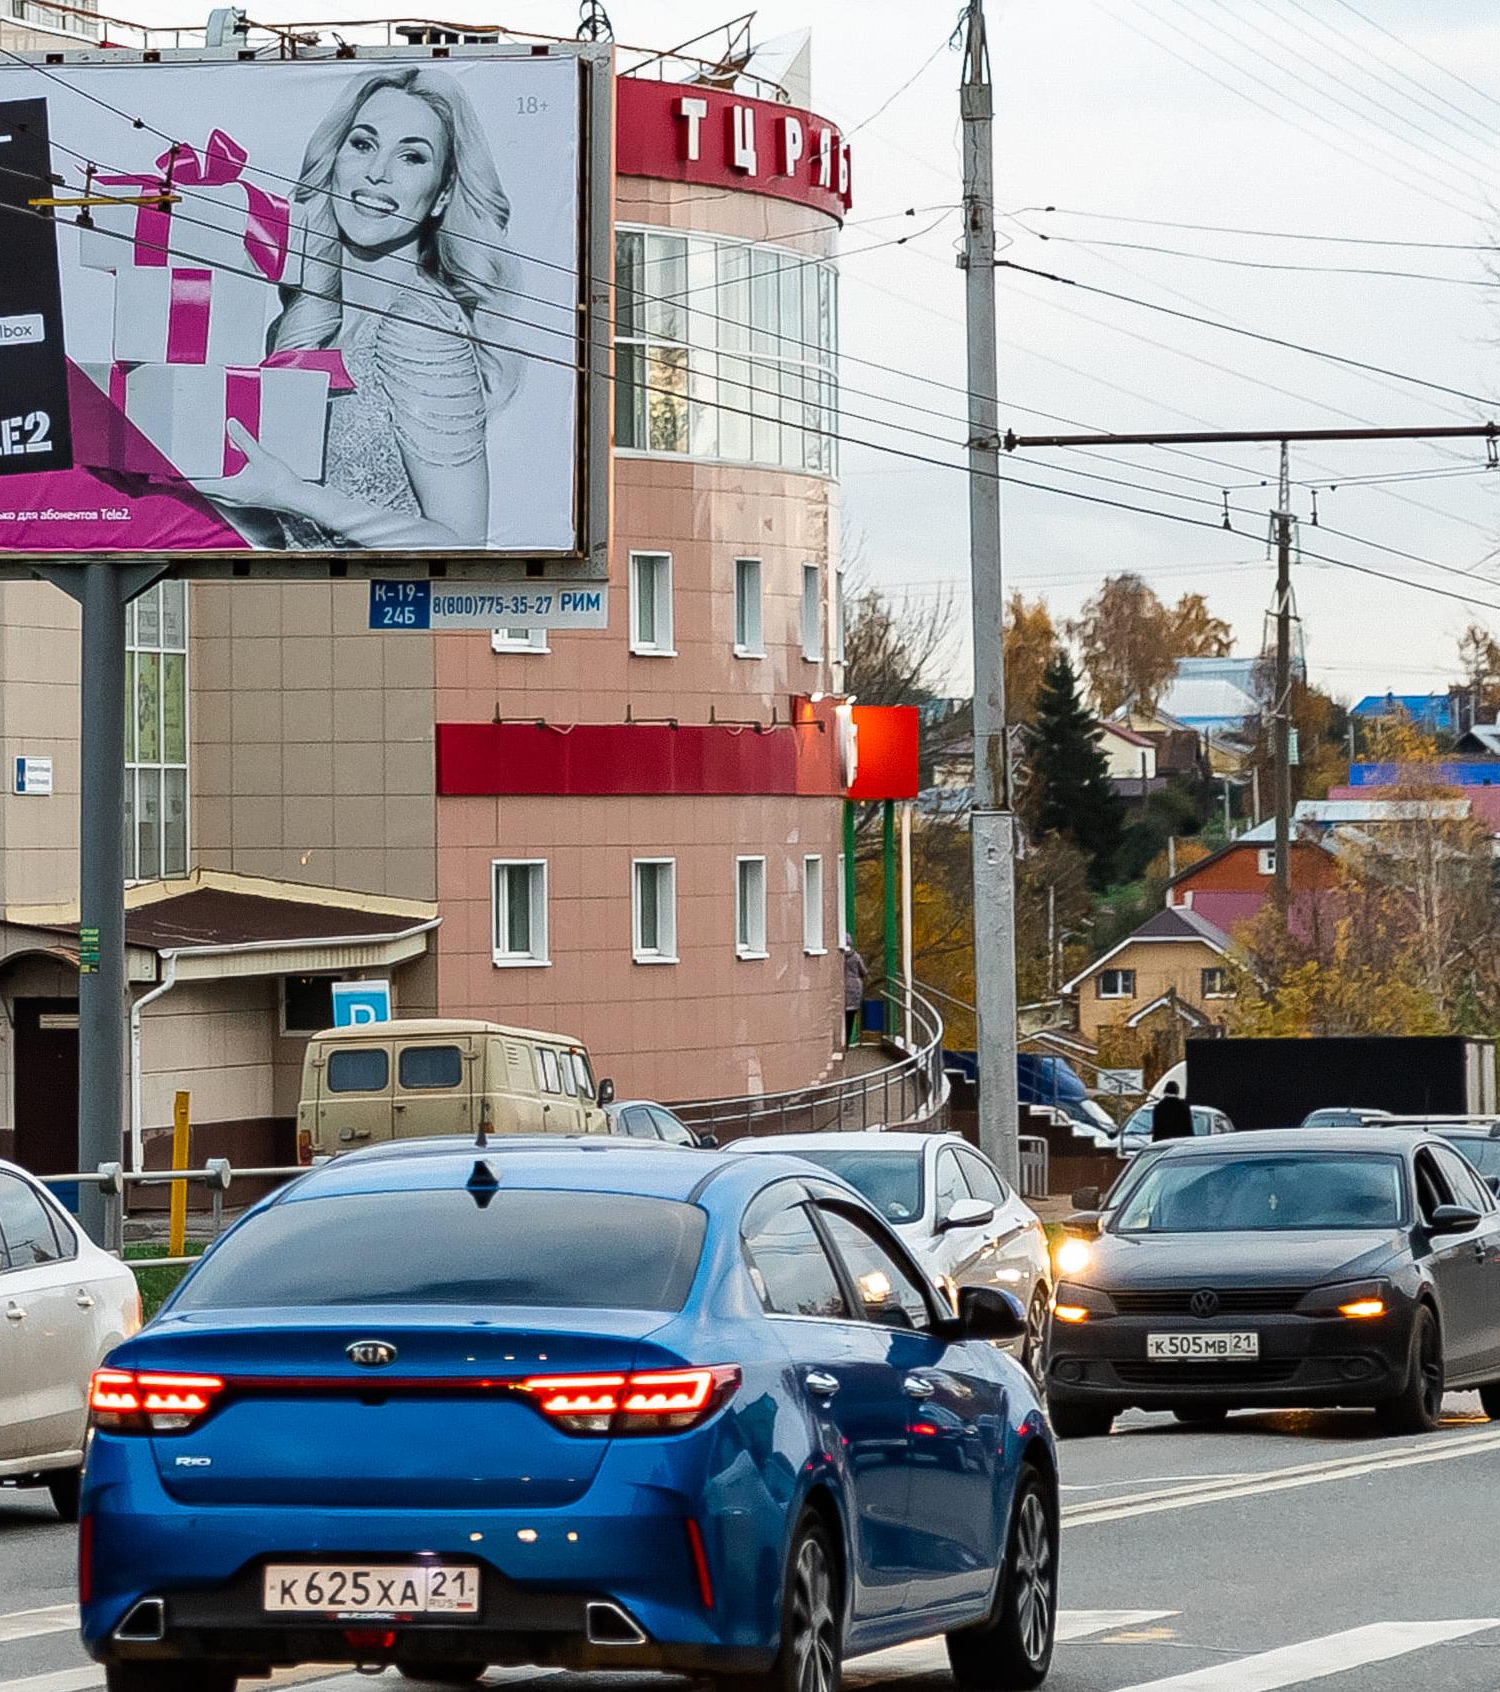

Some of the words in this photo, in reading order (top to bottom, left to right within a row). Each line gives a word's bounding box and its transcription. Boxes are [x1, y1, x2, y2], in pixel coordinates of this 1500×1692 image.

[517, 96, 549, 115] 18+
[17, 511, 39, 522] для
[40, 508, 99, 521] абонентов
[100, 508, 131, 521] Tele2.
[432, 594, 553, 616] 8(800)775-35-27
[560, 592, 601, 612] РИМ
[383, 607, 416, 625] 24Б
[1233, 1335, 1251, 1349] 21
[353, 1346, 389, 1363] KIA
[175, 1455, 211, 1467] RIO
[280, 1571, 419, 1606] К625ХА
[432, 1571, 466, 1597] 21
